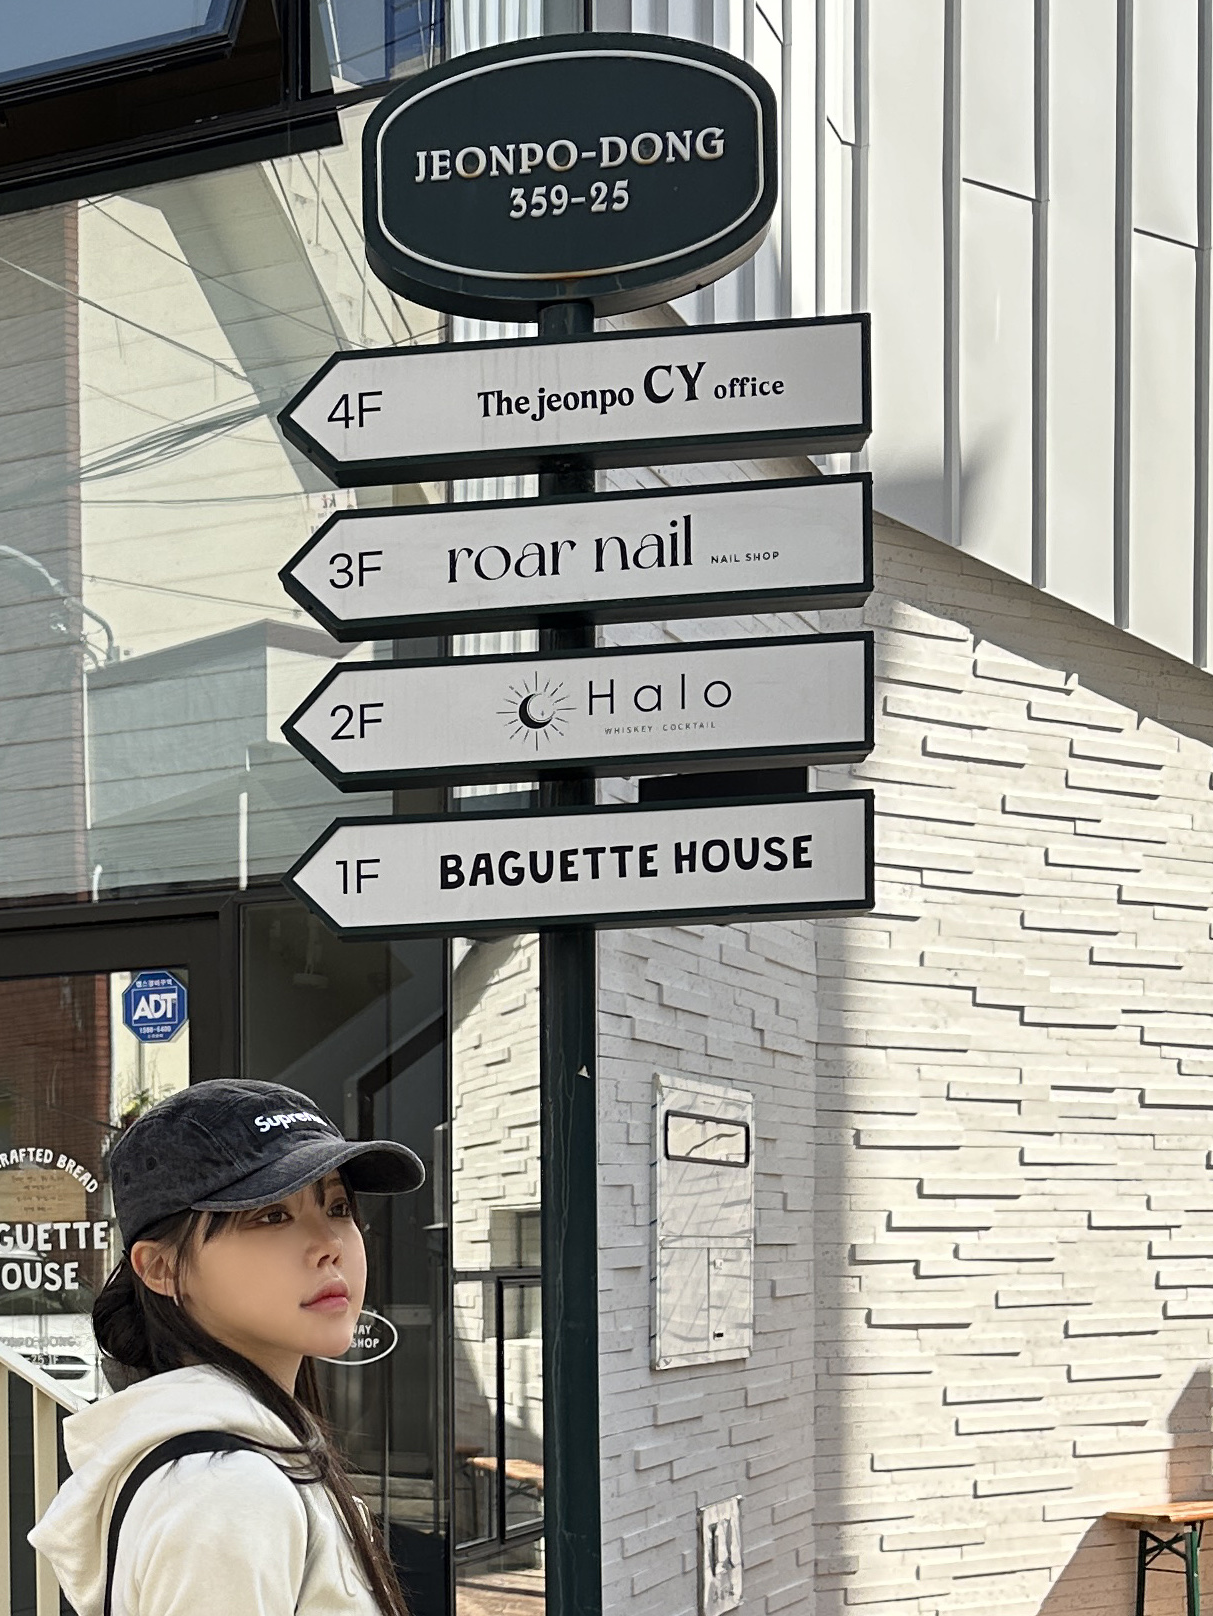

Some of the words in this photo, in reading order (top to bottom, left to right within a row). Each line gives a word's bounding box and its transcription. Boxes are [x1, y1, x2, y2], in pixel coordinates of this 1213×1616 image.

[414, 126, 726, 183] JEONPO-DONG
[509, 180, 630, 220] 359-25
[643, 361, 707, 404] CY
[713, 375, 785, 400] office
[327, 390, 383, 430] 4F
[448, 539, 576, 583] roar
[594, 515, 693, 572] nail
[711, 554, 740, 564] NAIL
[745, 551, 780, 562] SHOP
[329, 550, 383, 589] 3F
[588, 673, 733, 716] Halo
[330, 702, 384, 741] 2F
[604, 725, 653, 735] WHISKEY
[662, 721, 716, 732] COCKTAIL
[335, 858, 381, 894] 1F
[439, 843, 659, 890] BAGUETTE
[674, 834, 813, 874] HOUSE
[133, 993, 177, 1020] ADT
[56, 1154, 99, 1194] BREAD
